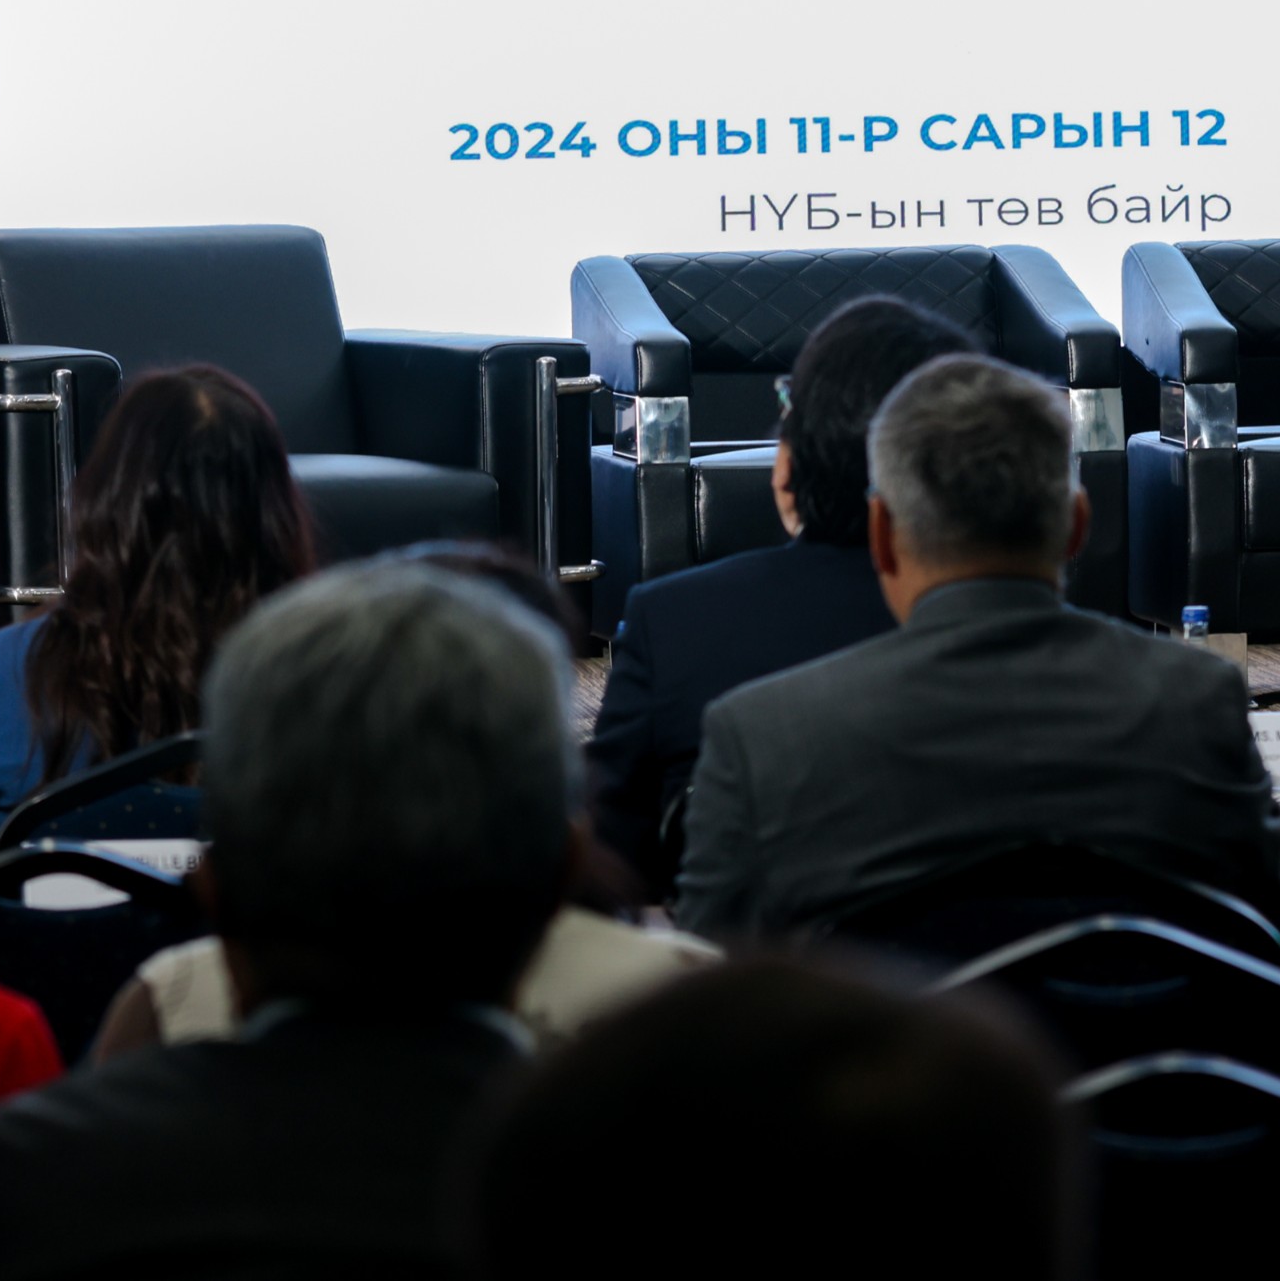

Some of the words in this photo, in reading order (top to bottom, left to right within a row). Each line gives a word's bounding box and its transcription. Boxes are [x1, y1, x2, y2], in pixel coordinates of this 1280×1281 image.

[449, 121, 599, 162] 2024
[618, 118, 769, 159] ОНЫ
[789, 115, 901, 156] 11-Р
[920, 111, 1152, 153] САРЫН
[1172, 109, 1229, 148] 12
[720, 192, 947, 233] НҮБ-ын
[966, 197, 1065, 228] төв
[1086, 183, 1234, 233] байр
